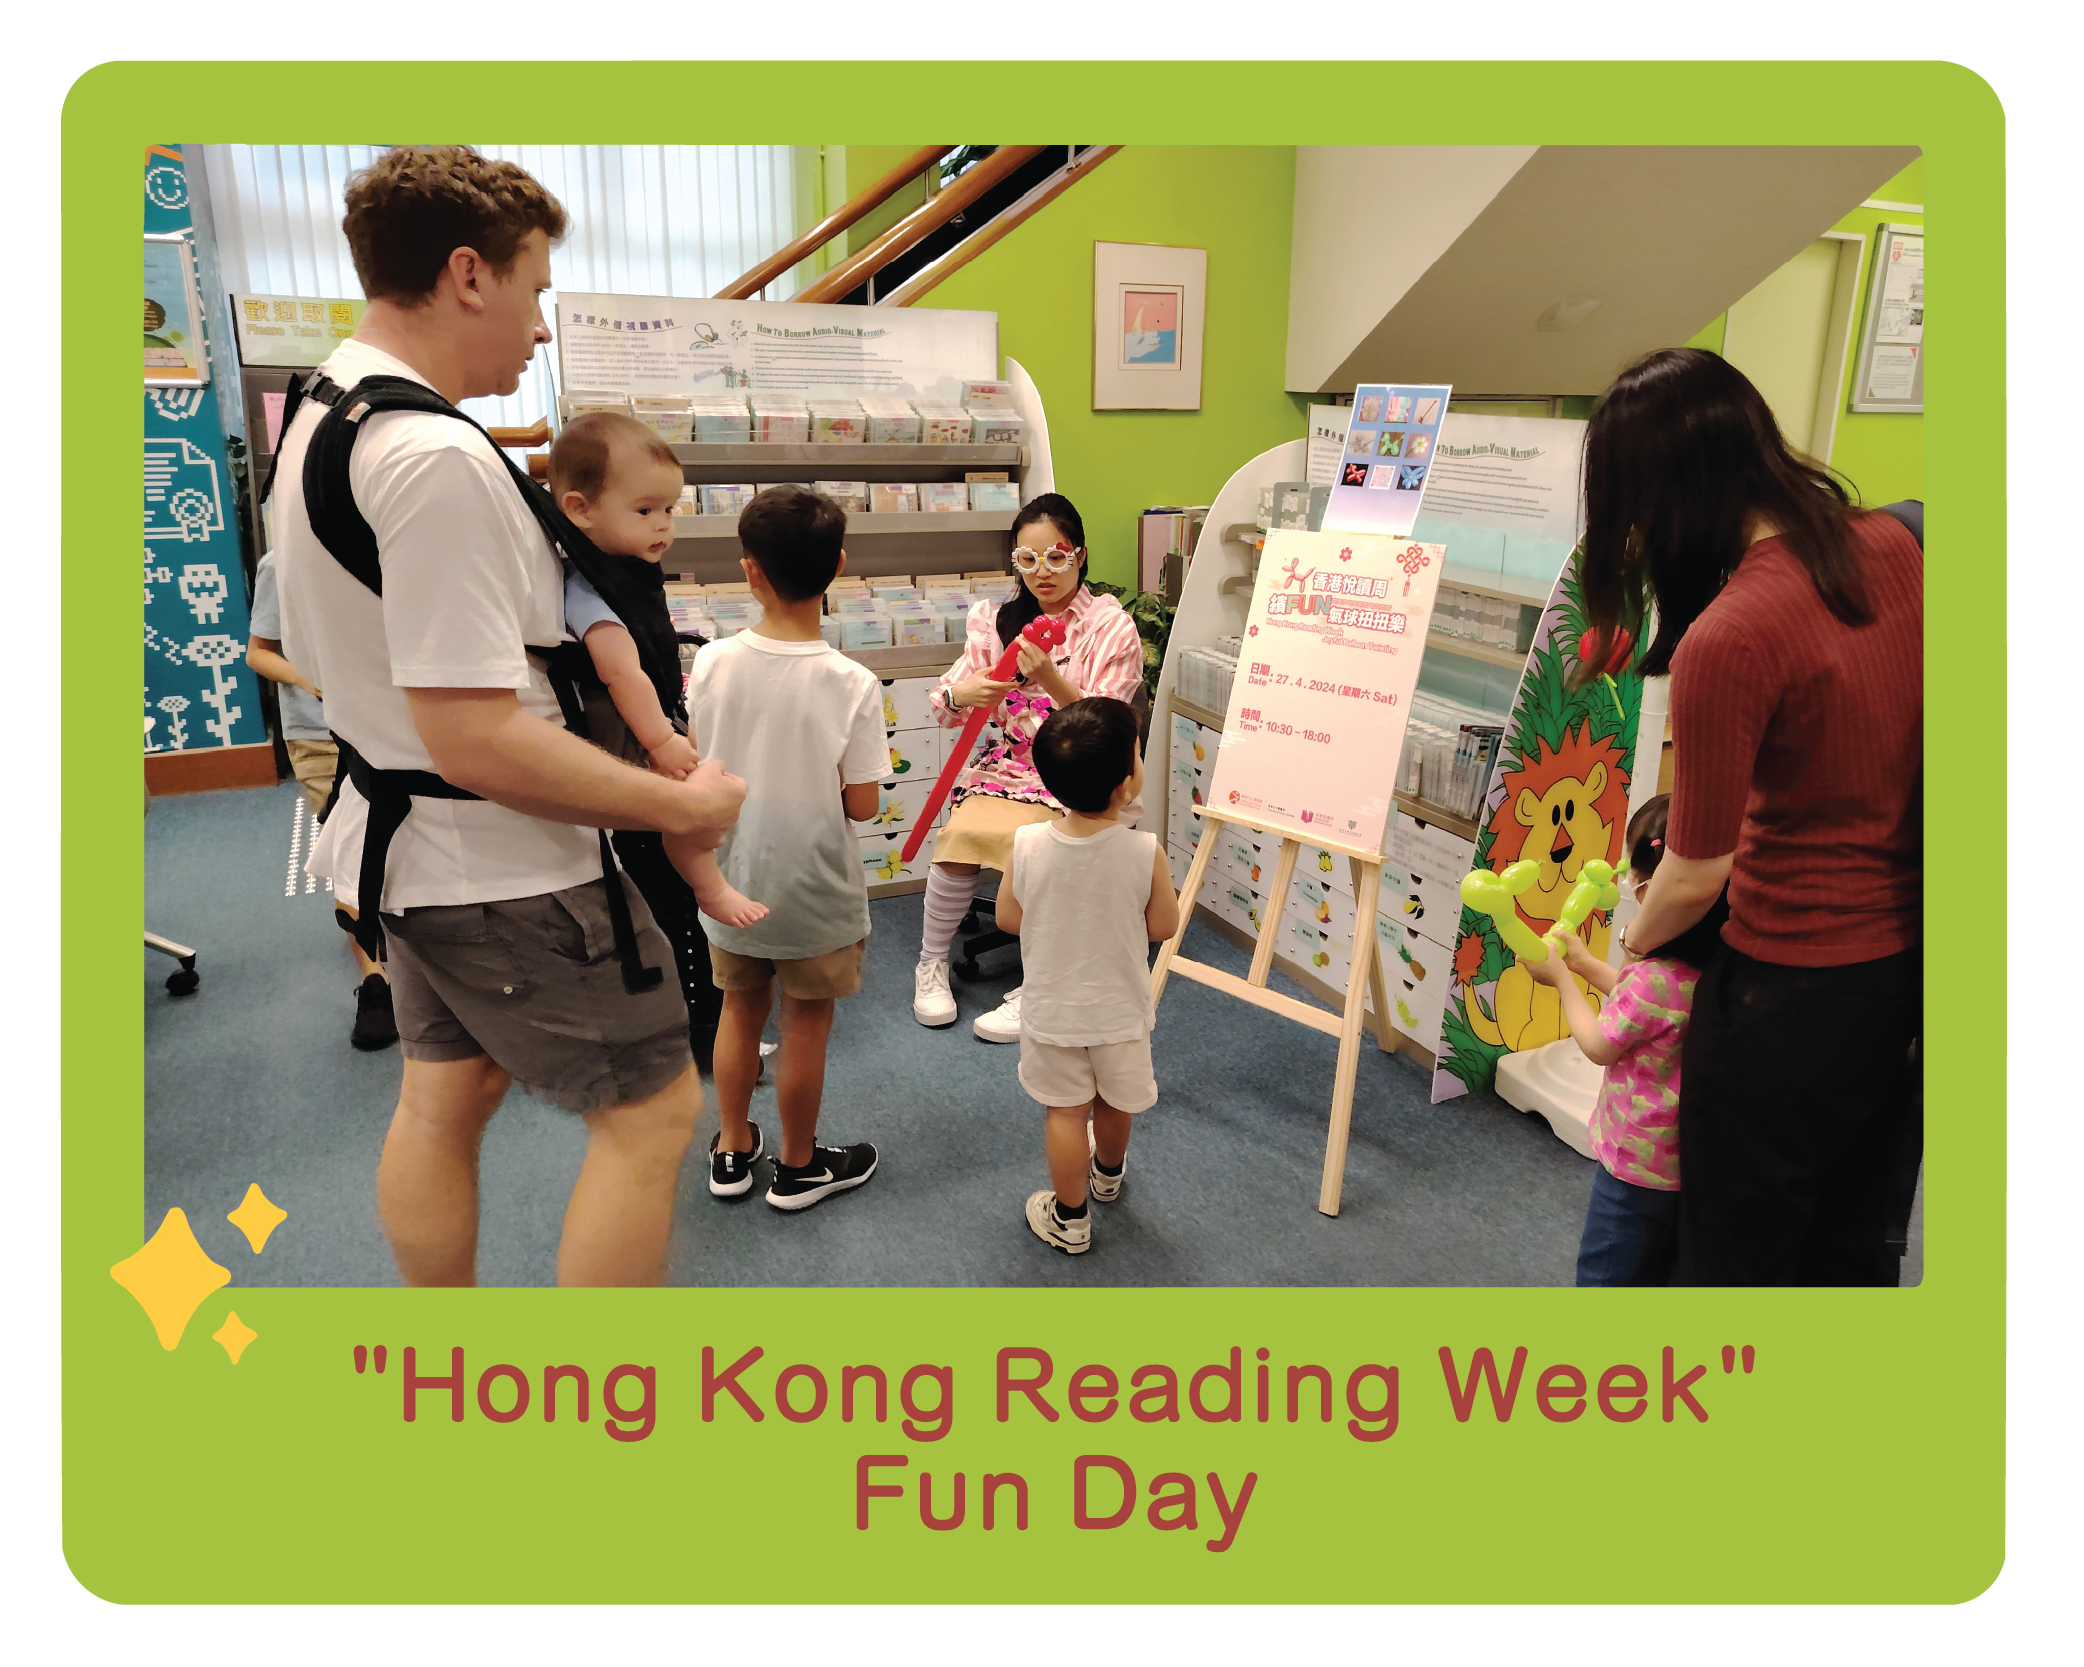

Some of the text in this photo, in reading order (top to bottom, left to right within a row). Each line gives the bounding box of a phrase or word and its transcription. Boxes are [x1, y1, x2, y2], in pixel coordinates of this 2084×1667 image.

[244, 300, 353, 325] 歡迎取閱
[246, 323, 354, 338] Please Take One
[1312, 572, 1388, 599] 香港悅讀周
[1266, 617, 1345, 637] Hong Kong Reading Week
[1322, 635, 1398, 656] Joyful Balloon Twisting
[1372, 691, 1398, 707] Sat)
[1265, 721, 1293, 736] 10:30
[1302, 729, 1331, 744] 18:00
